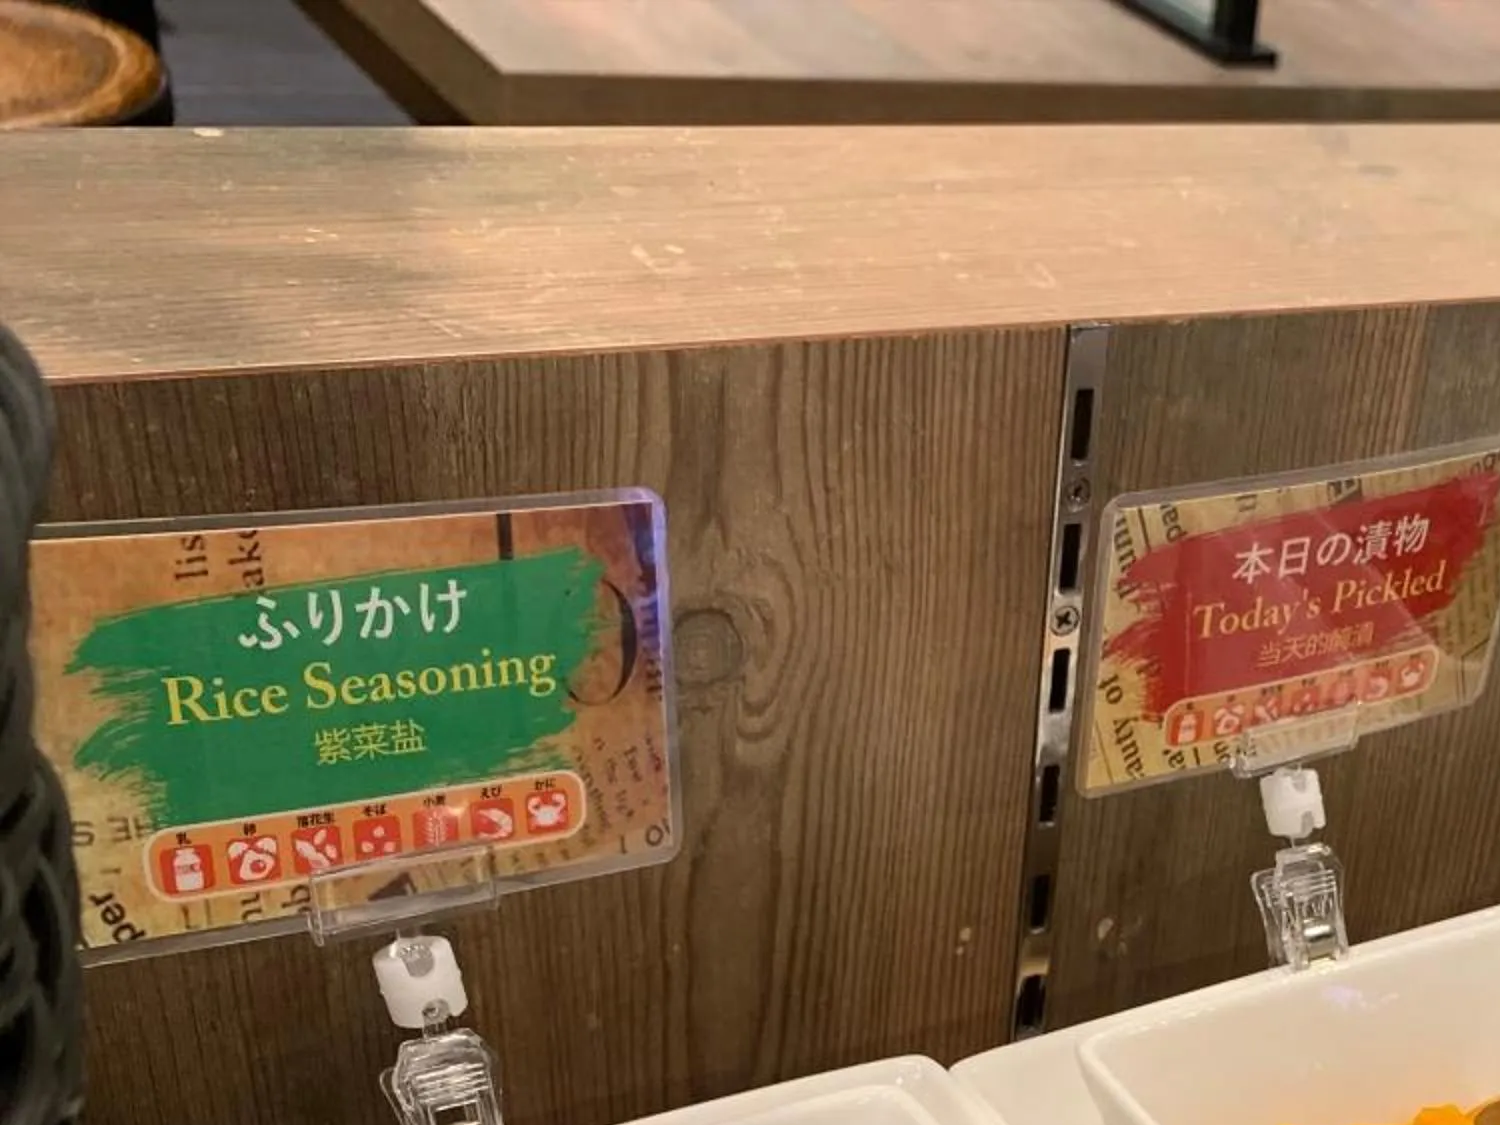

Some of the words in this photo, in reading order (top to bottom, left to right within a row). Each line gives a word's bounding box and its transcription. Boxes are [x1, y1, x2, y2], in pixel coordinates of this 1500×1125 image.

[1232, 513, 1430, 584] 本日の漬物
[238, 580, 467, 650] ふりかけ
[1193, 588, 1321, 639] Today's
[1331, 560, 1447, 614] Pickled
[161, 674, 289, 726] Rice
[303, 648, 557, 709] Seasoning
[315, 717, 427, 766] 紫菜盐
